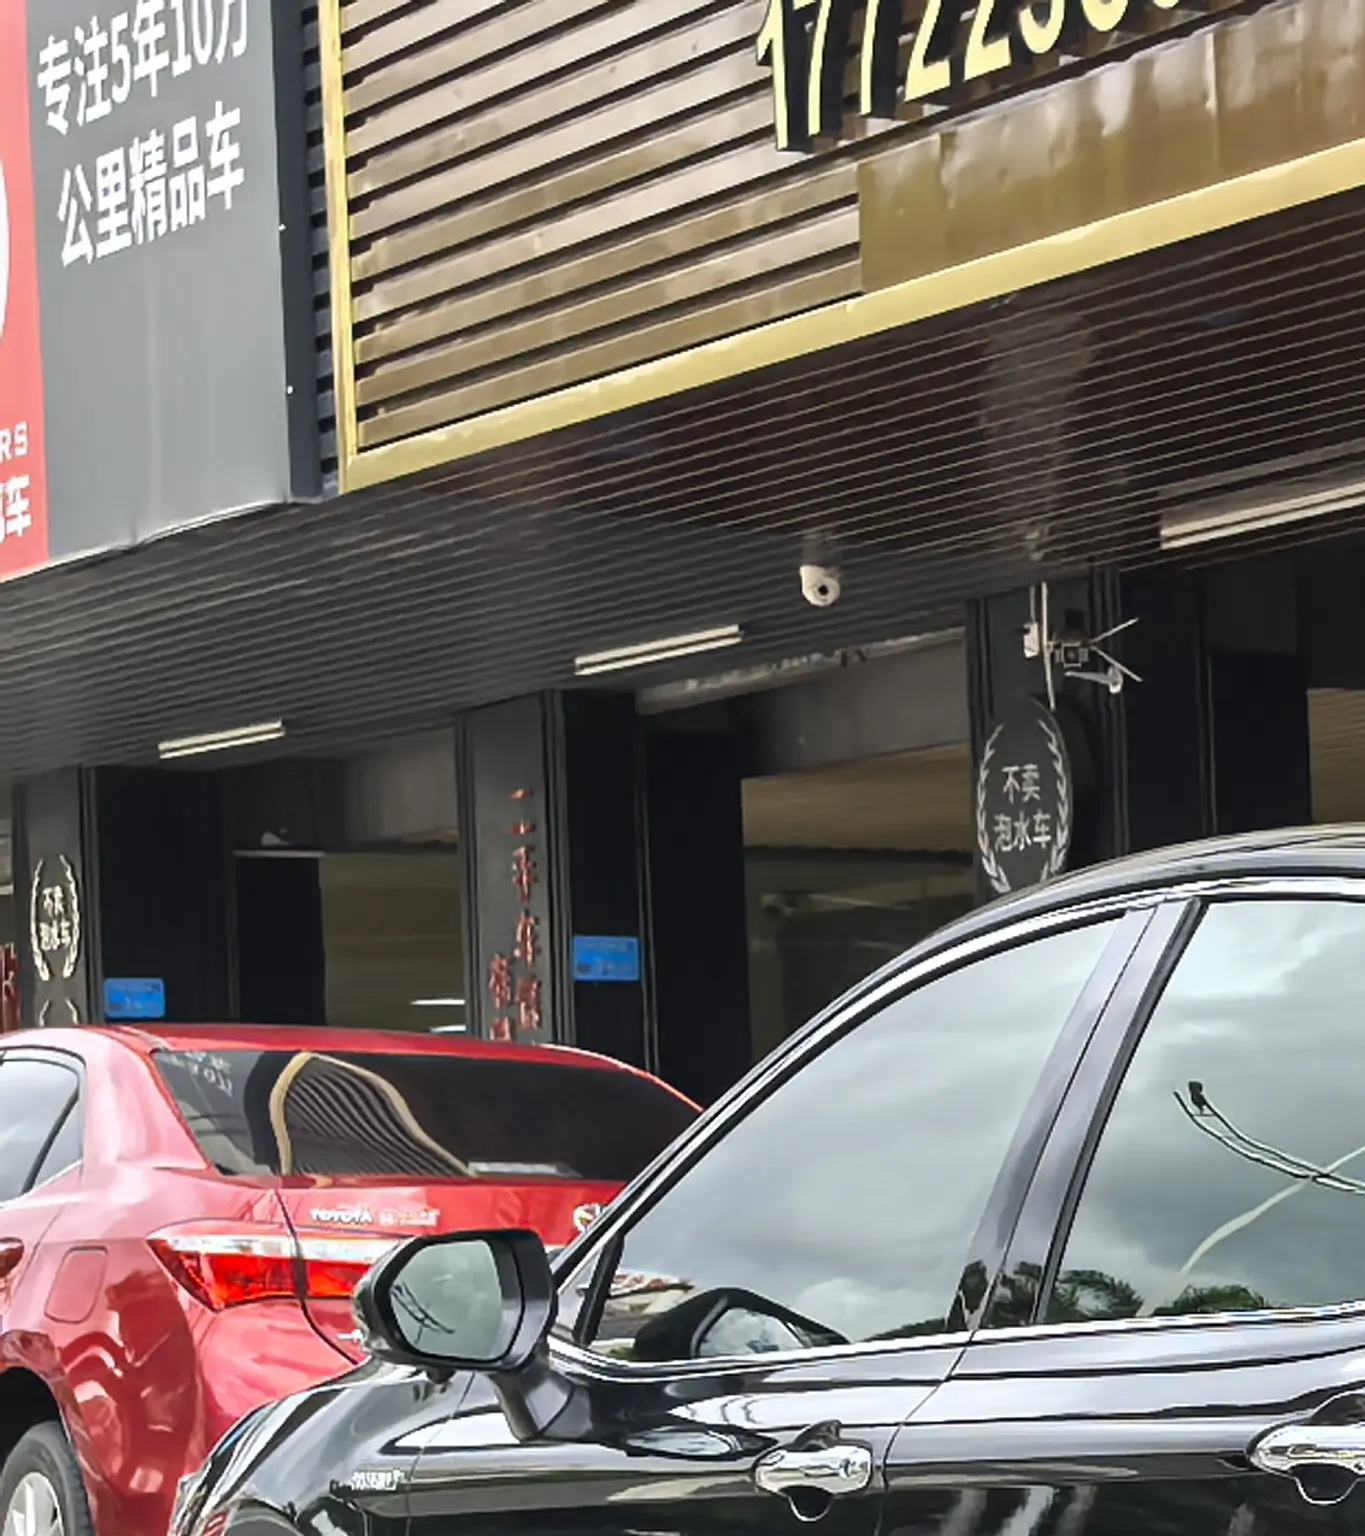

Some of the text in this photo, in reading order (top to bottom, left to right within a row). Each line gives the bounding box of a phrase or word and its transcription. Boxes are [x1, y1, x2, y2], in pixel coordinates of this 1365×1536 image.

[756, 0, 1176, 149] 17722
[57, 101, 244, 267] 公里精品车
[0, 474, 32, 544] 车
[1002, 764, 1040, 803] 不卖
[994, 811, 1051, 852] 泡水车
[311, 1207, 374, 1225] TOYOTA
